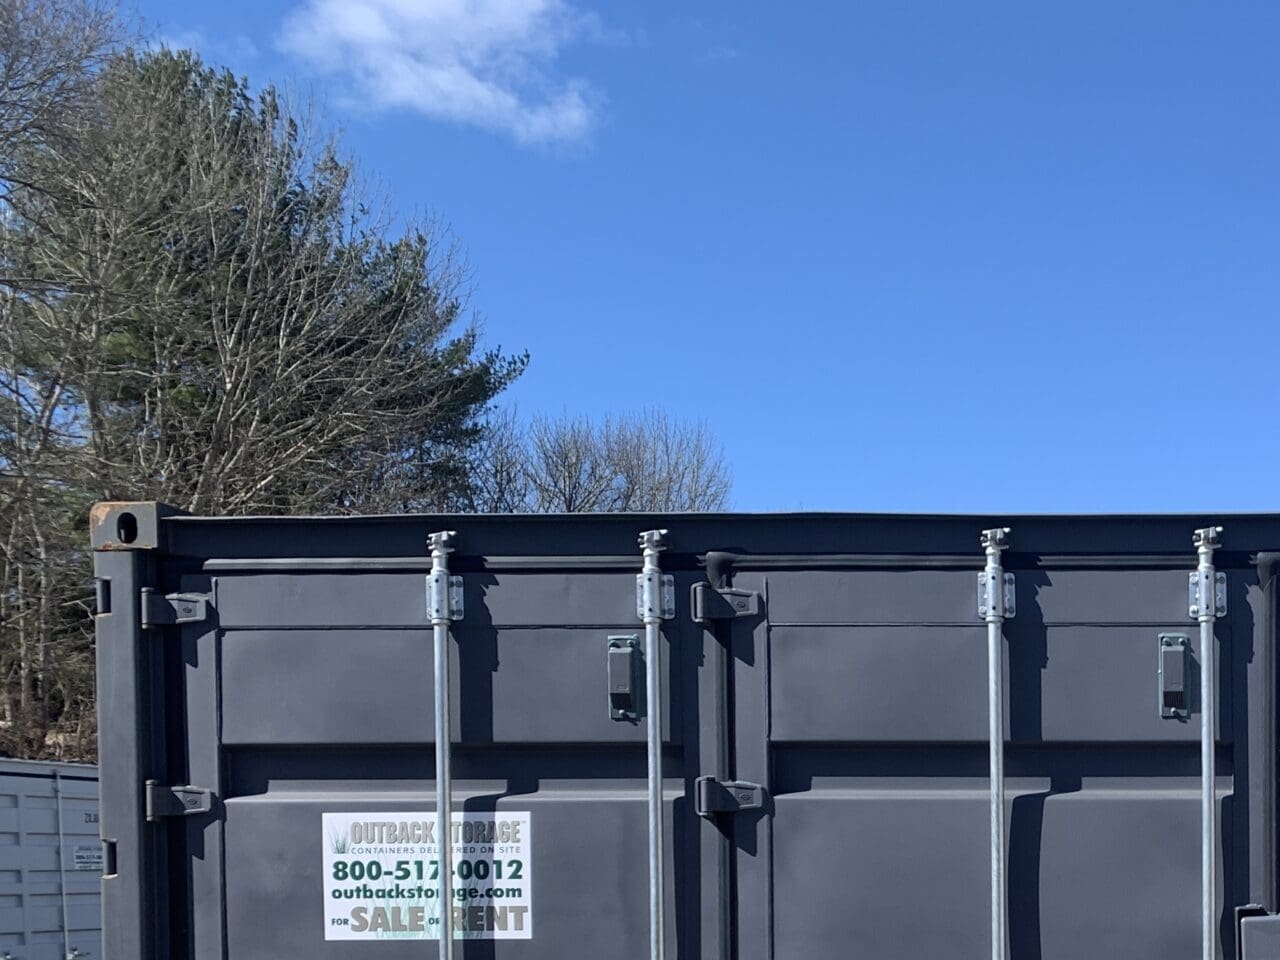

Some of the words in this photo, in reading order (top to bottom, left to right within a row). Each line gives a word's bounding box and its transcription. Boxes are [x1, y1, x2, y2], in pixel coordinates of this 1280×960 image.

[350, 821, 436, 844] OUTBACK
[449, 821, 521, 844] TORAGE
[351, 847, 416, 855] CONTAINERS
[420, 846, 476, 854] DELRED
[331, 918, 349, 926] FOR
[350, 906, 425, 932] SALE
